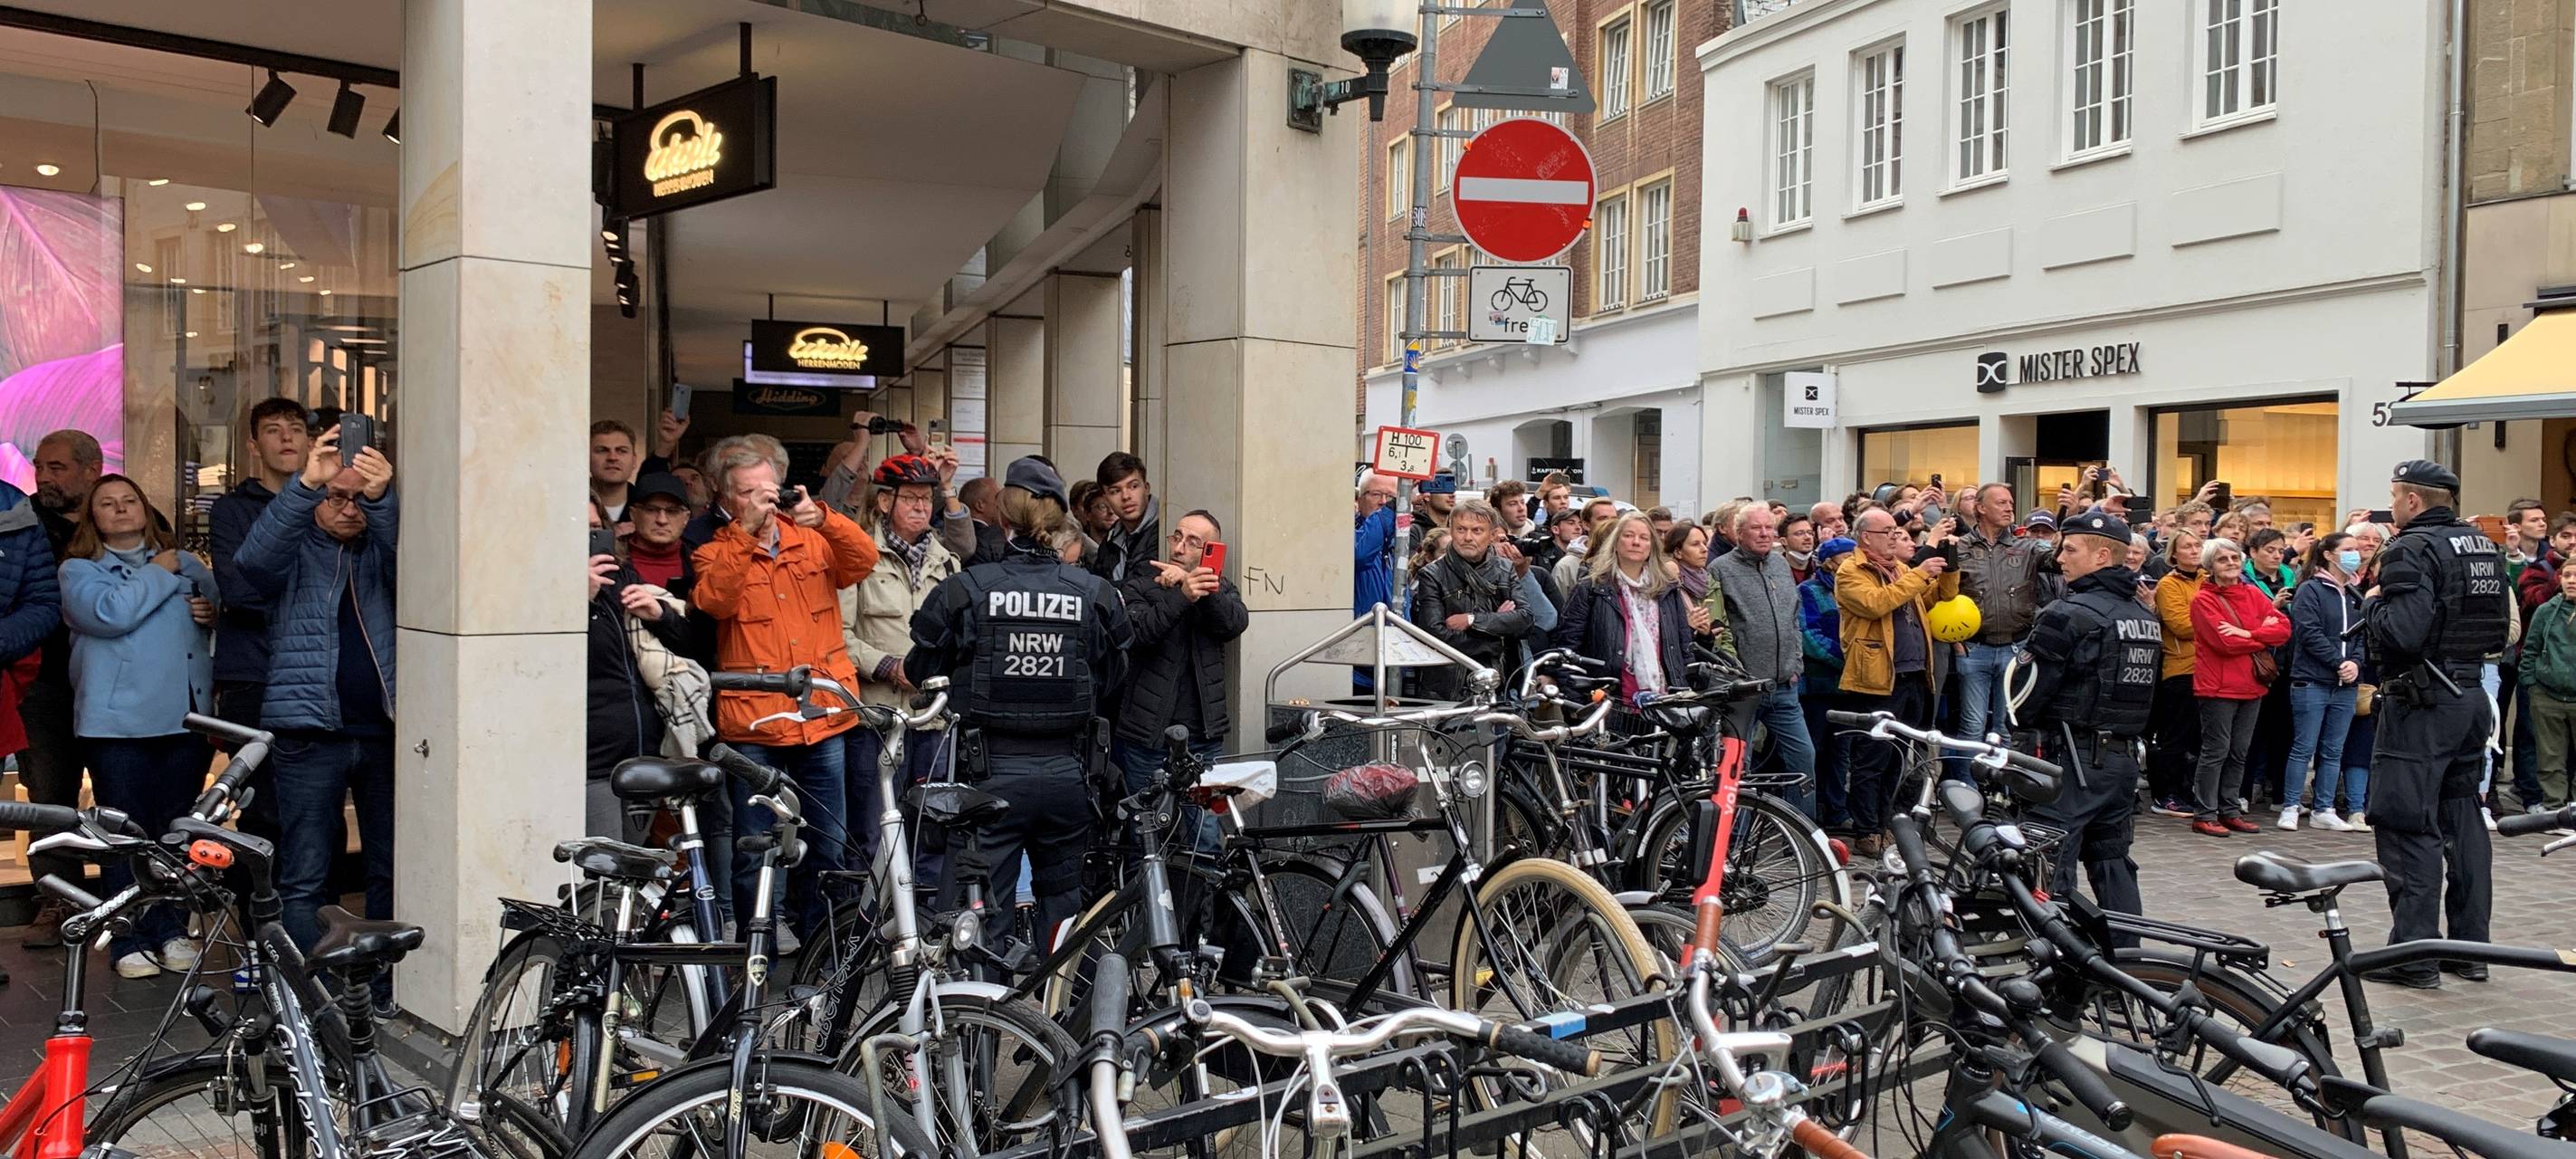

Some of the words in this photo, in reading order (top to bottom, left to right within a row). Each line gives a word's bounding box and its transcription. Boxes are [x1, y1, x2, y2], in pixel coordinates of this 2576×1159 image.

[1340, 81, 1350, 94] 10
[1503, 317, 1530, 332] fre
[797, 359, 861, 370] HERRENMODEN
[2019, 349, 2086, 384] MISTER
[2091, 341, 2142, 376] SPEX
[755, 388, 818, 406] Hidding
[1793, 407, 1814, 416] MISTER
[1814, 407, 1829, 417] SPEX
[1391, 432, 1399, 444] H
[1404, 435, 1422, 445] 100
[2469, 561, 2495, 578] NRW
[2471, 580, 2501, 595] 2822
[988, 590, 1083, 621] POLIZEI
[1008, 632, 1064, 653] NRW
[2127, 647, 2155, 665] NRW
[1004, 655, 1064, 676] 2821
[2122, 666, 2154, 685] 2823
